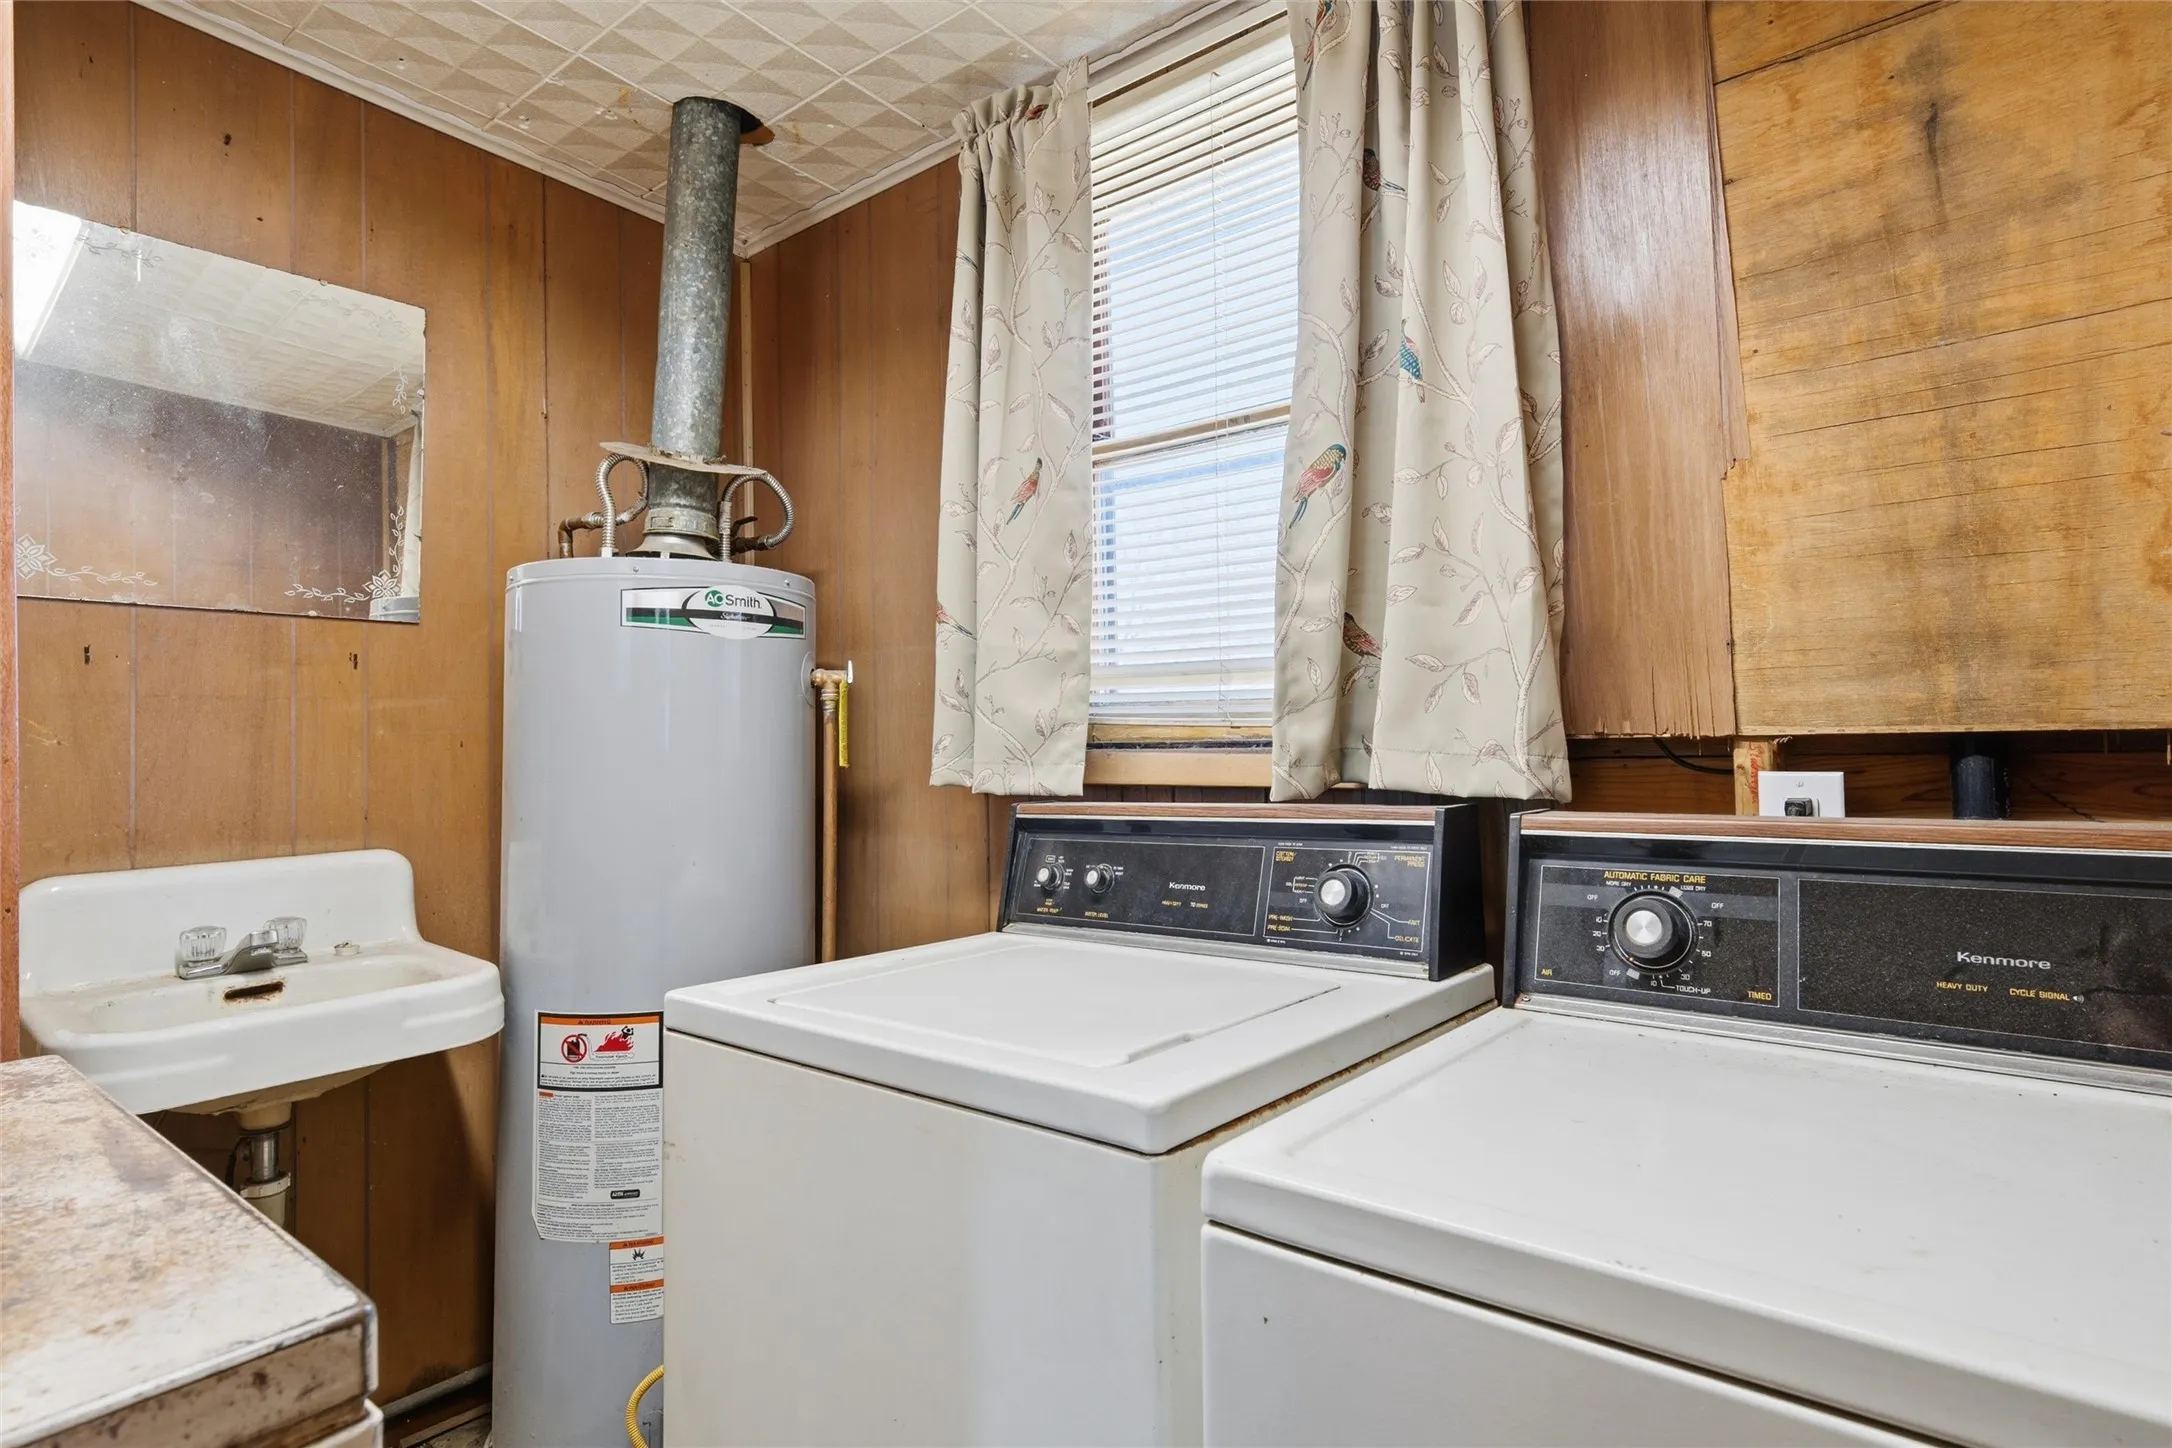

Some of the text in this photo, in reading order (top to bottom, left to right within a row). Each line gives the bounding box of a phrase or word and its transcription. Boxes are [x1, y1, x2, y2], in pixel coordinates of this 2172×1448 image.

[725, 594, 761, 609] Smith
[1604, 870, 1706, 884] AUTOMATIC FABRIC CARE
[1169, 882, 1206, 892] Kenmore
[1957, 951, 2051, 970] Kenmore
[1541, 968, 1553, 976] AIR
[1676, 985, 1711, 995] TOUCH-UP
[1936, 981, 1988, 993] HEAVY DUTY
[1747, 991, 1772, 1001] TIMED
[2009, 988, 2070, 1002] CYCLE SIGNAL
